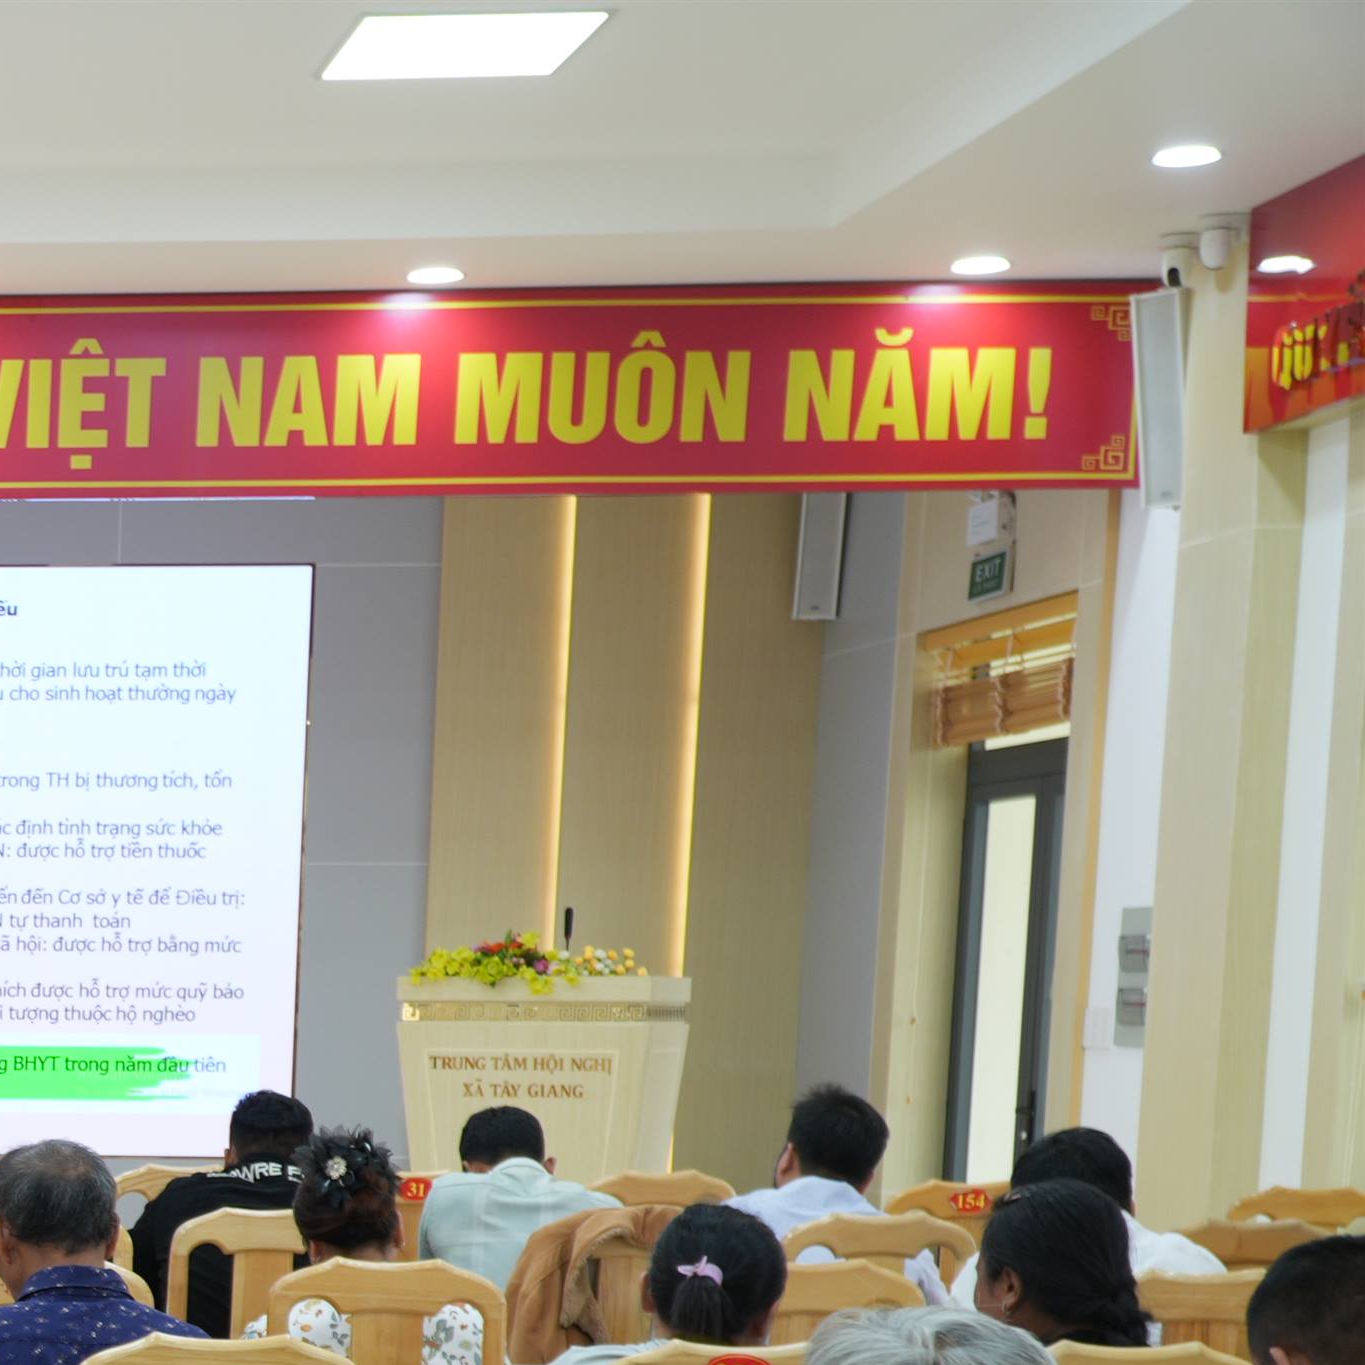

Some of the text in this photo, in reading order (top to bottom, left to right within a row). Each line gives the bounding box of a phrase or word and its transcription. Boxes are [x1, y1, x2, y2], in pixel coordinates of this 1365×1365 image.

[196, 354, 422, 447] NAM
[455, 330, 751, 445] MUÔN
[784, 327, 1053, 442] NĂM!
[30, 662, 67, 682] gian
[73, 661, 100, 678] lưu
[105, 660, 129, 678] trú
[134, 664, 168, 684] tạm
[173, 659, 207, 678] thời
[9, 685, 40, 701] cho
[45, 685, 80, 701] sinh
[85, 684, 124, 704] hoạt
[127, 683, 191, 705] thường
[195, 683, 237, 704] ngày
[16, 842, 60, 862] được
[64, 837, 85, 858] hỗ
[91, 844, 116, 862] trợ
[121, 841, 153, 858] tiền
[157, 841, 206, 859] thuốc
[14, 1056, 59, 1071] BHYT
[65, 1057, 109, 1075] trong
[116, 1056, 152, 1072] năm
[157, 1056, 189, 1072] đầu
[194, 1056, 226, 1072] tiên
[429, 1053, 612, 1075] TRUNG TÂM HỘI NGHỊ
[463, 1079, 584, 1098] XÃ TÂY GIANG
[407, 1182, 424, 1198] 31
[959, 1193, 984, 1209] 154
